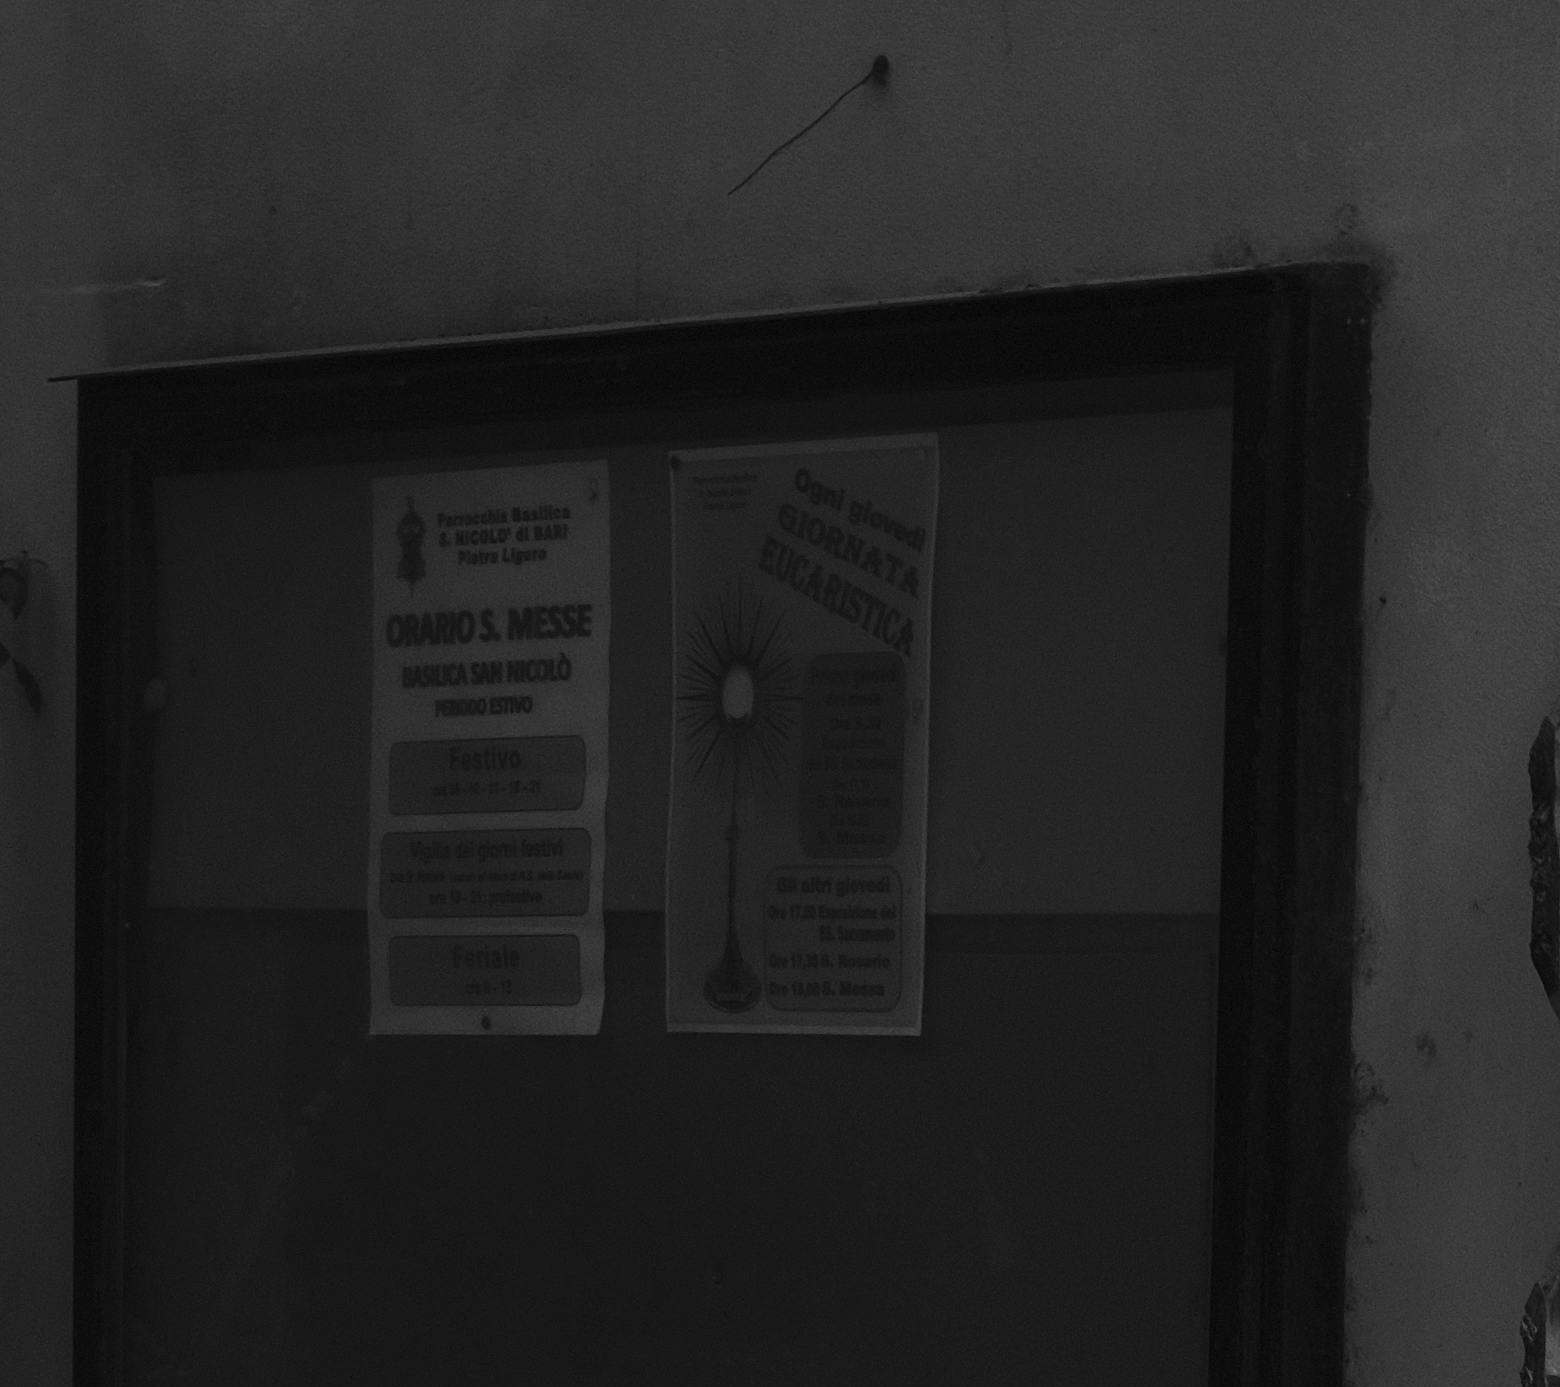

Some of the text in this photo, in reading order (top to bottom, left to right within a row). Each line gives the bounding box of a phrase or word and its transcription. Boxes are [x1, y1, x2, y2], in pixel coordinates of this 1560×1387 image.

[793, 466, 846, 511] Ogni
[512, 505, 571, 522] Basilica
[439, 530, 450, 547] S.
[515, 526, 529, 542] di
[534, 523, 568, 541] BARI
[458, 550, 499, 566] Pietra
[778, 503, 920, 600] GIORNATA
[757, 534, 914, 657] EUCARISTICA
[386, 604, 592, 648] ORARIO S. MESSE
[402, 652, 572, 688] BASILICA SAN NICOLÒ
[434, 697, 533, 717] PERIODO ESTIVO
[449, 748, 522, 770] Festivo
[409, 838, 564, 864] Vigilia dei giorni festivi
[801, 876, 832, 893] altri
[767, 904, 787, 921] Ore
[452, 944, 520, 969] Feriale
[768, 952, 788, 969] Ore
[838, 952, 892, 969] Rosario
[768, 981, 789, 997] Ore
[839, 981, 886, 997] Messa
